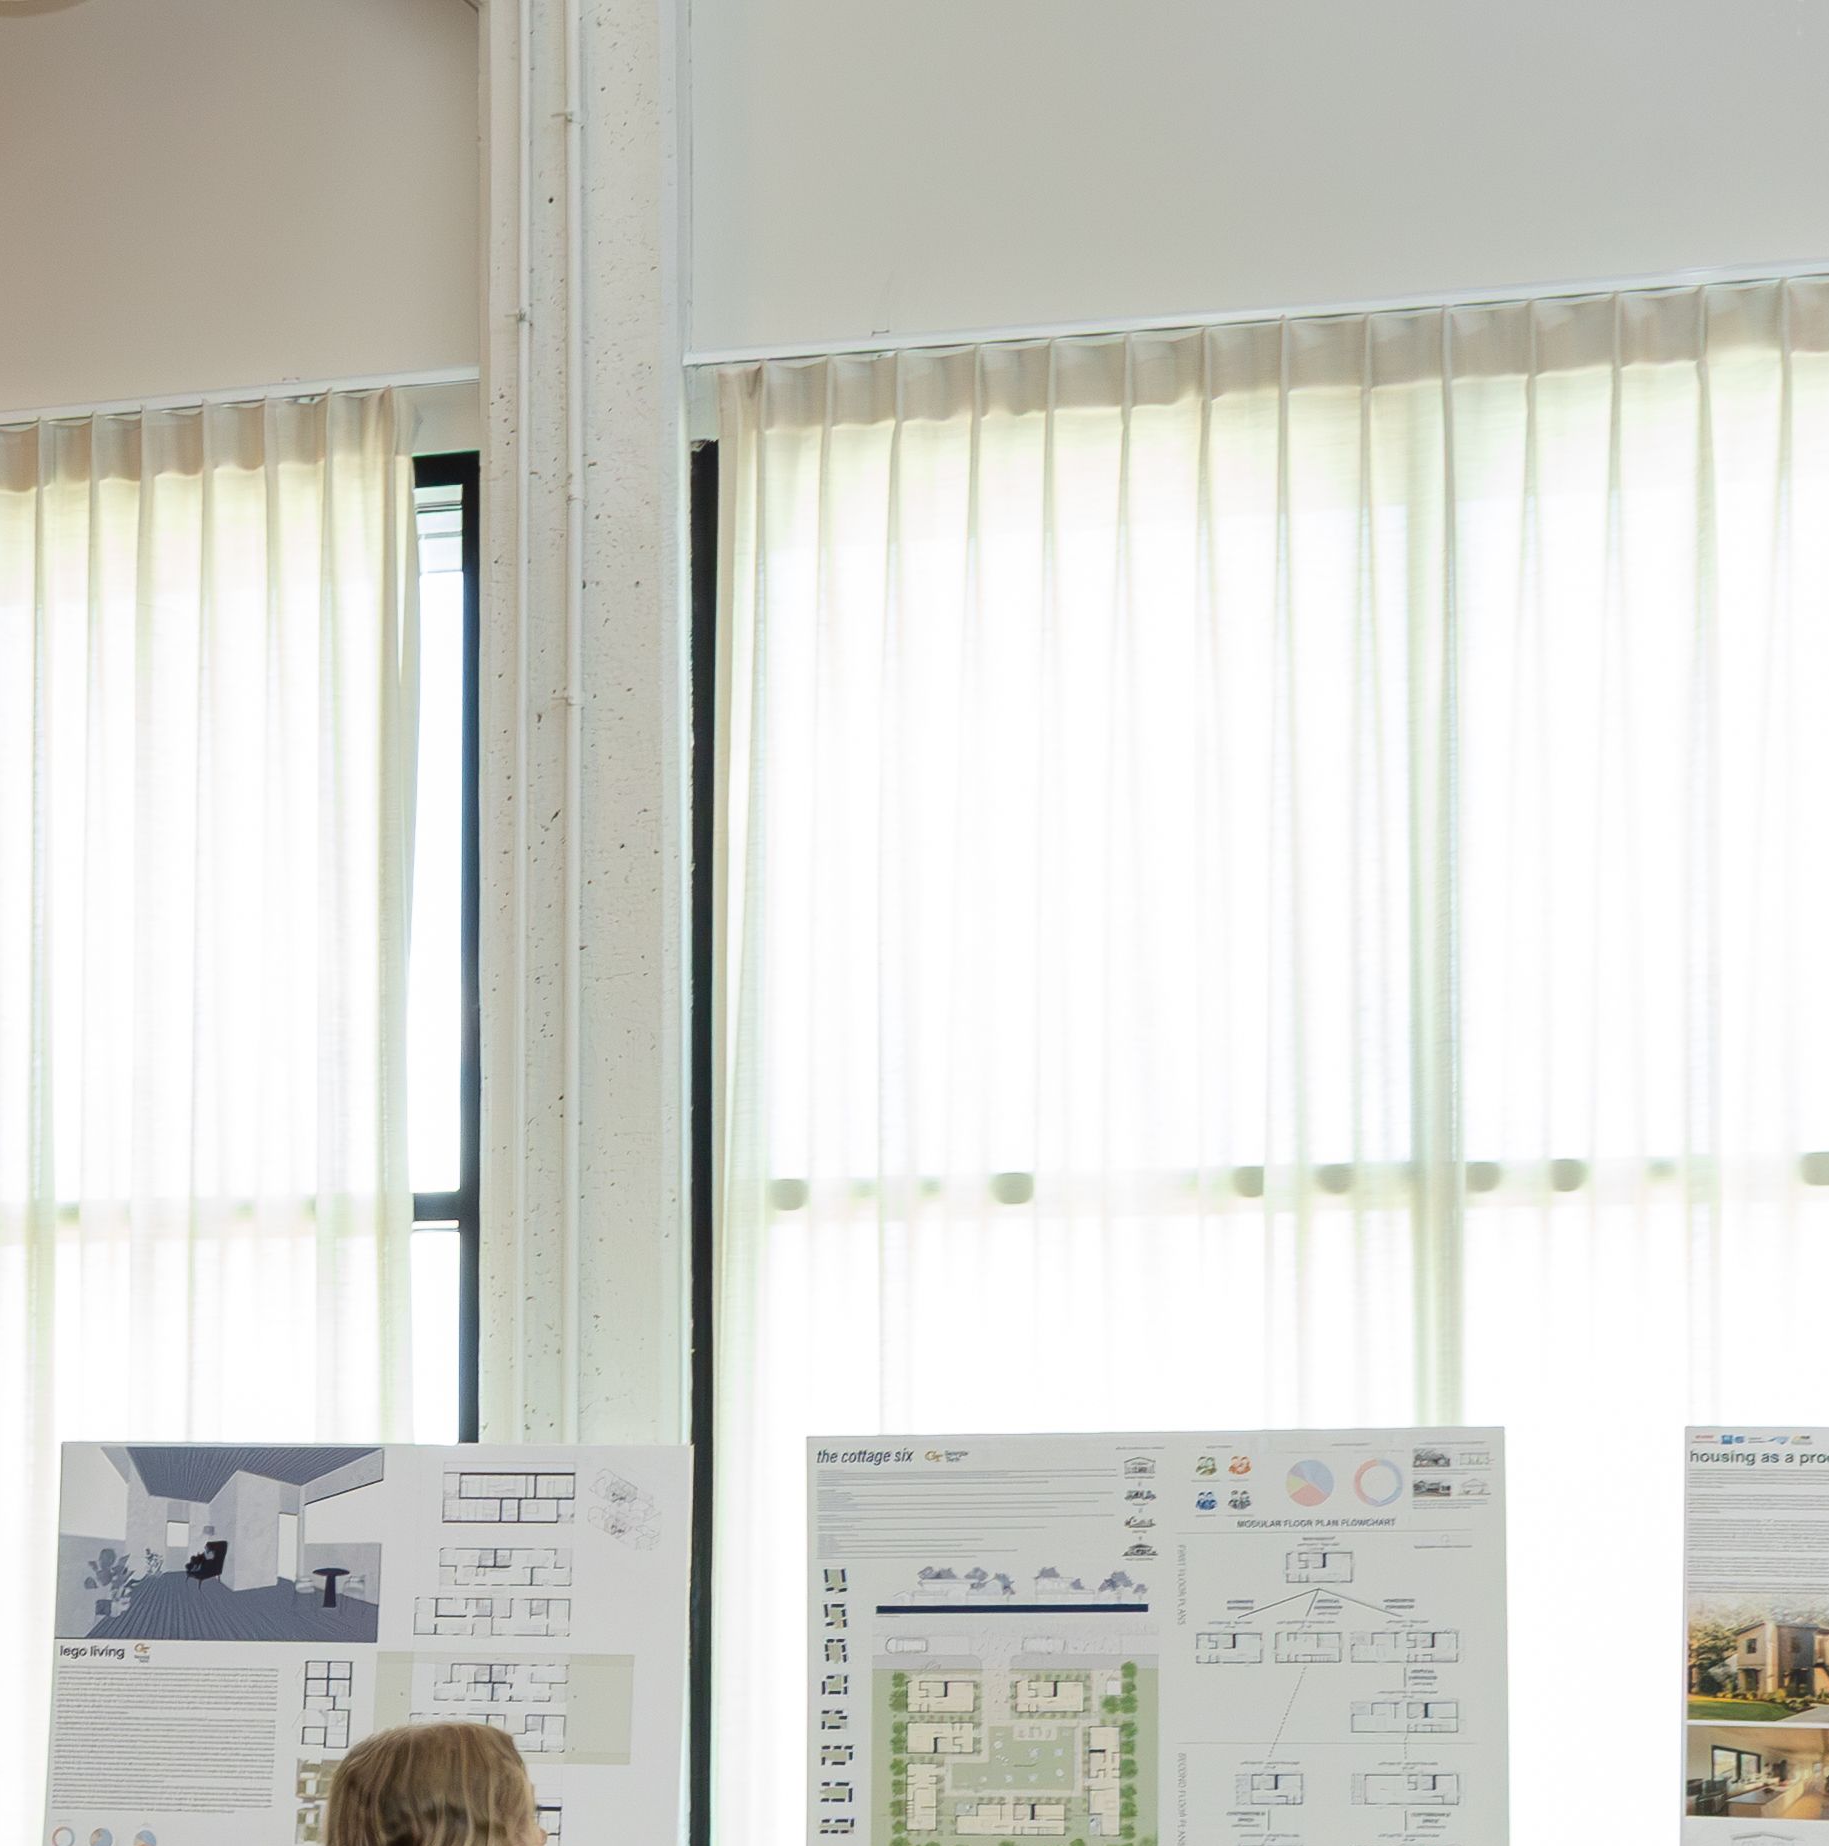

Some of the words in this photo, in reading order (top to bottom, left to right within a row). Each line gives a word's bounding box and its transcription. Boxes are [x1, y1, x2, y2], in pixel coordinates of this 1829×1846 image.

[816, 1449, 838, 1464] the
[841, 1450, 891, 1466] cottage
[894, 1448, 915, 1463] six
[1690, 1450, 1756, 1466] housing
[1760, 1454, 1780, 1464] as
[1784, 1454, 1794, 1464] a
[60, 1645, 88, 1660] lego
[90, 1644, 125, 1660] living
